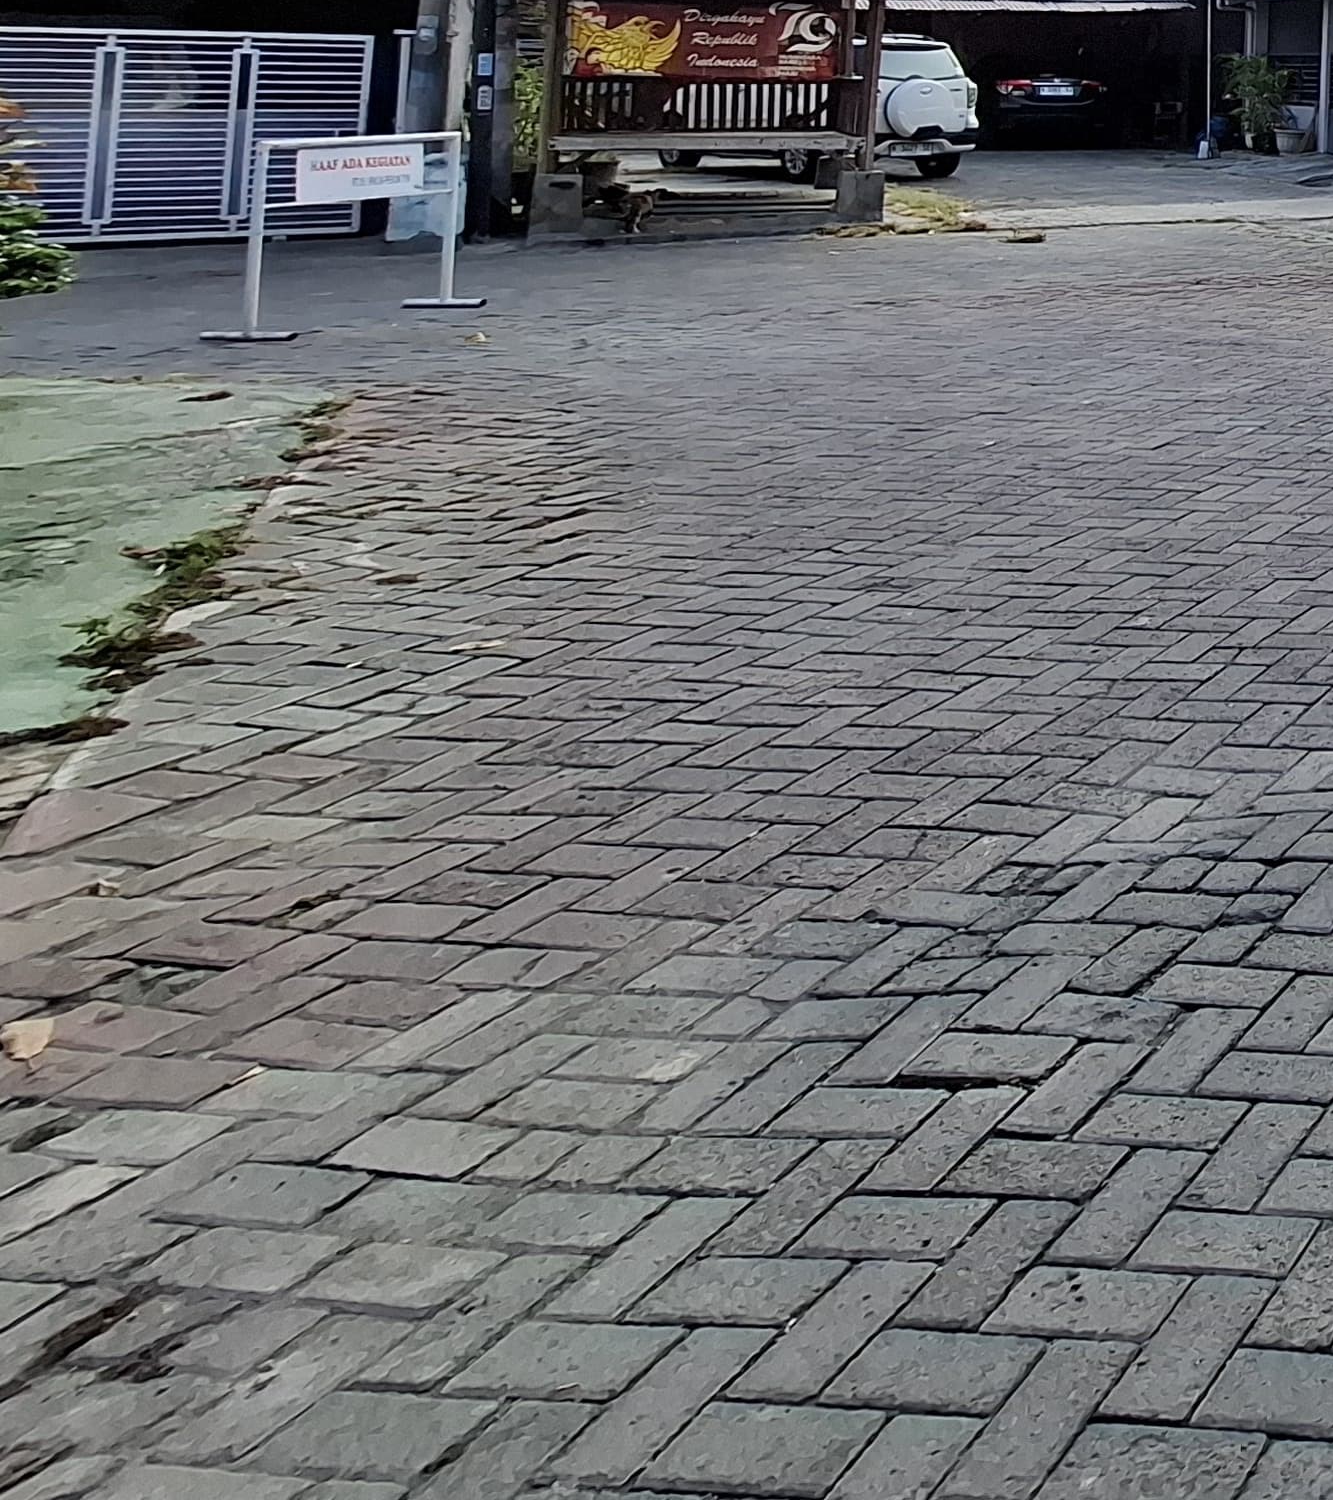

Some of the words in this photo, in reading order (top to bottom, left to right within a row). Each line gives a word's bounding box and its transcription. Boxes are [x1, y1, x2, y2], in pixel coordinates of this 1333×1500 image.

[683, 8, 767, 27] Dirgahayu
[691, 31, 759, 48] Republik
[686, 53, 760, 69] Indonesia
[341, 157, 363, 170] ADA
[365, 155, 412, 168] KEGIATAN
